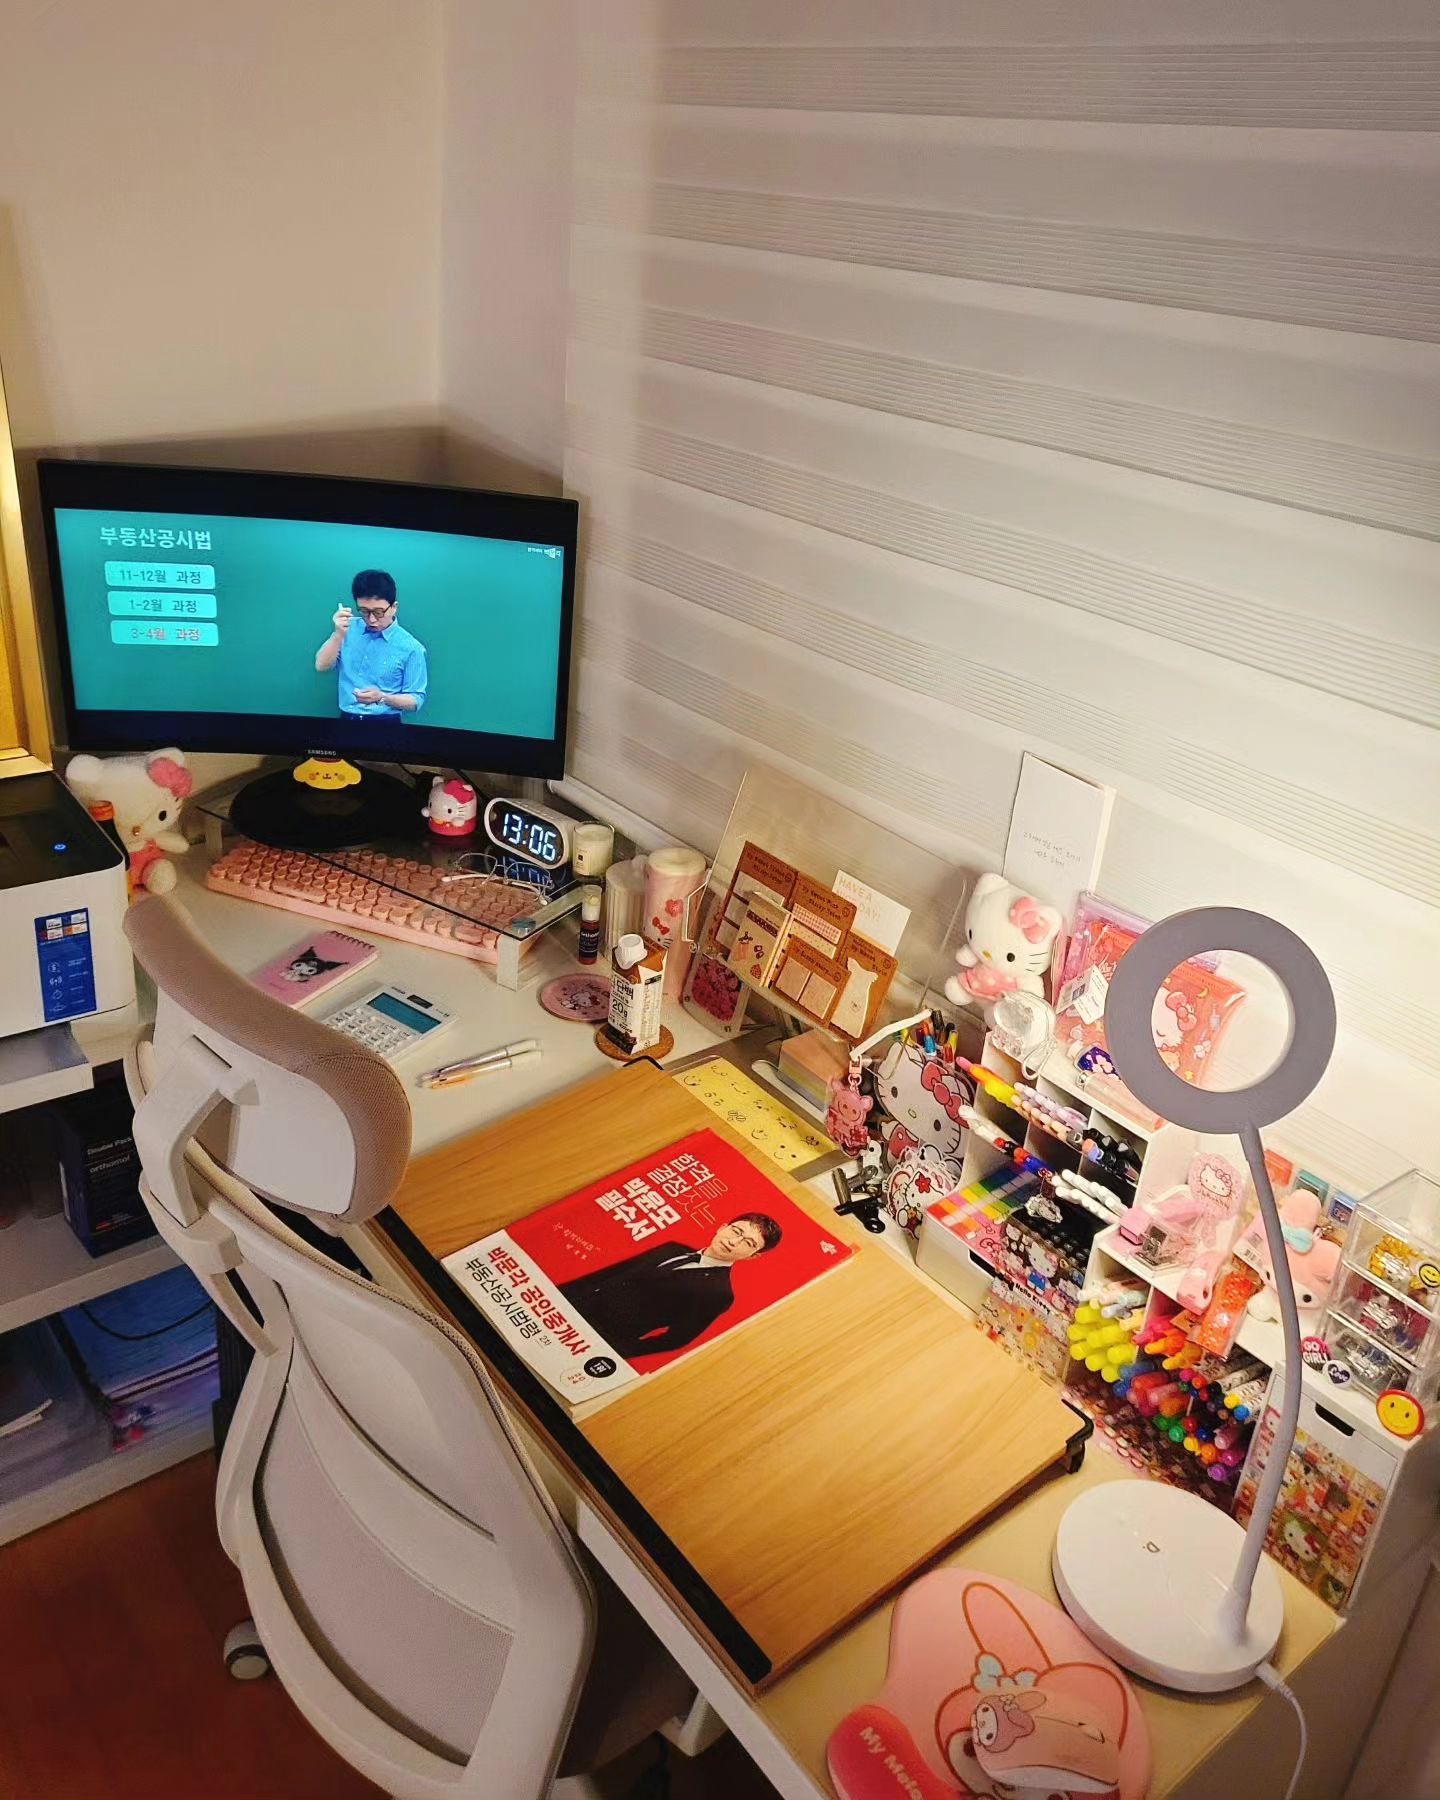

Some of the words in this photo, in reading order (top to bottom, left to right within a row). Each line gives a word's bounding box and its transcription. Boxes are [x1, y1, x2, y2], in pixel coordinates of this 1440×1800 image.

[100, 527, 212, 550] 부동산공시법
[120, 569, 166, 583] 11-12월
[176, 570, 201, 584] 과정
[129, 599, 162, 612] 1-2월
[172, 600, 197, 613] 과정
[175, 628, 200, 641] 과정
[503, 813, 557, 861] 13:06
[612, 999, 628, 1018] 20g
[670, 1153, 728, 1200] 합격을
[622, 1177, 682, 1231] 박윤모
[647, 1164, 716, 1230] 결정짓는
[594, 1189, 657, 1242] 필수서
[465, 1257, 542, 1339] 부동산공시법령
[487, 1246, 530, 1288] 박문각
[520, 1285, 591, 1356] 공인중개사
[1015, 1282, 1032, 1298] Hello
[1032, 1294, 1051, 1315] Kitty
[1303, 1341, 1321, 1351] GO
[860, 1726, 886, 1754] My
